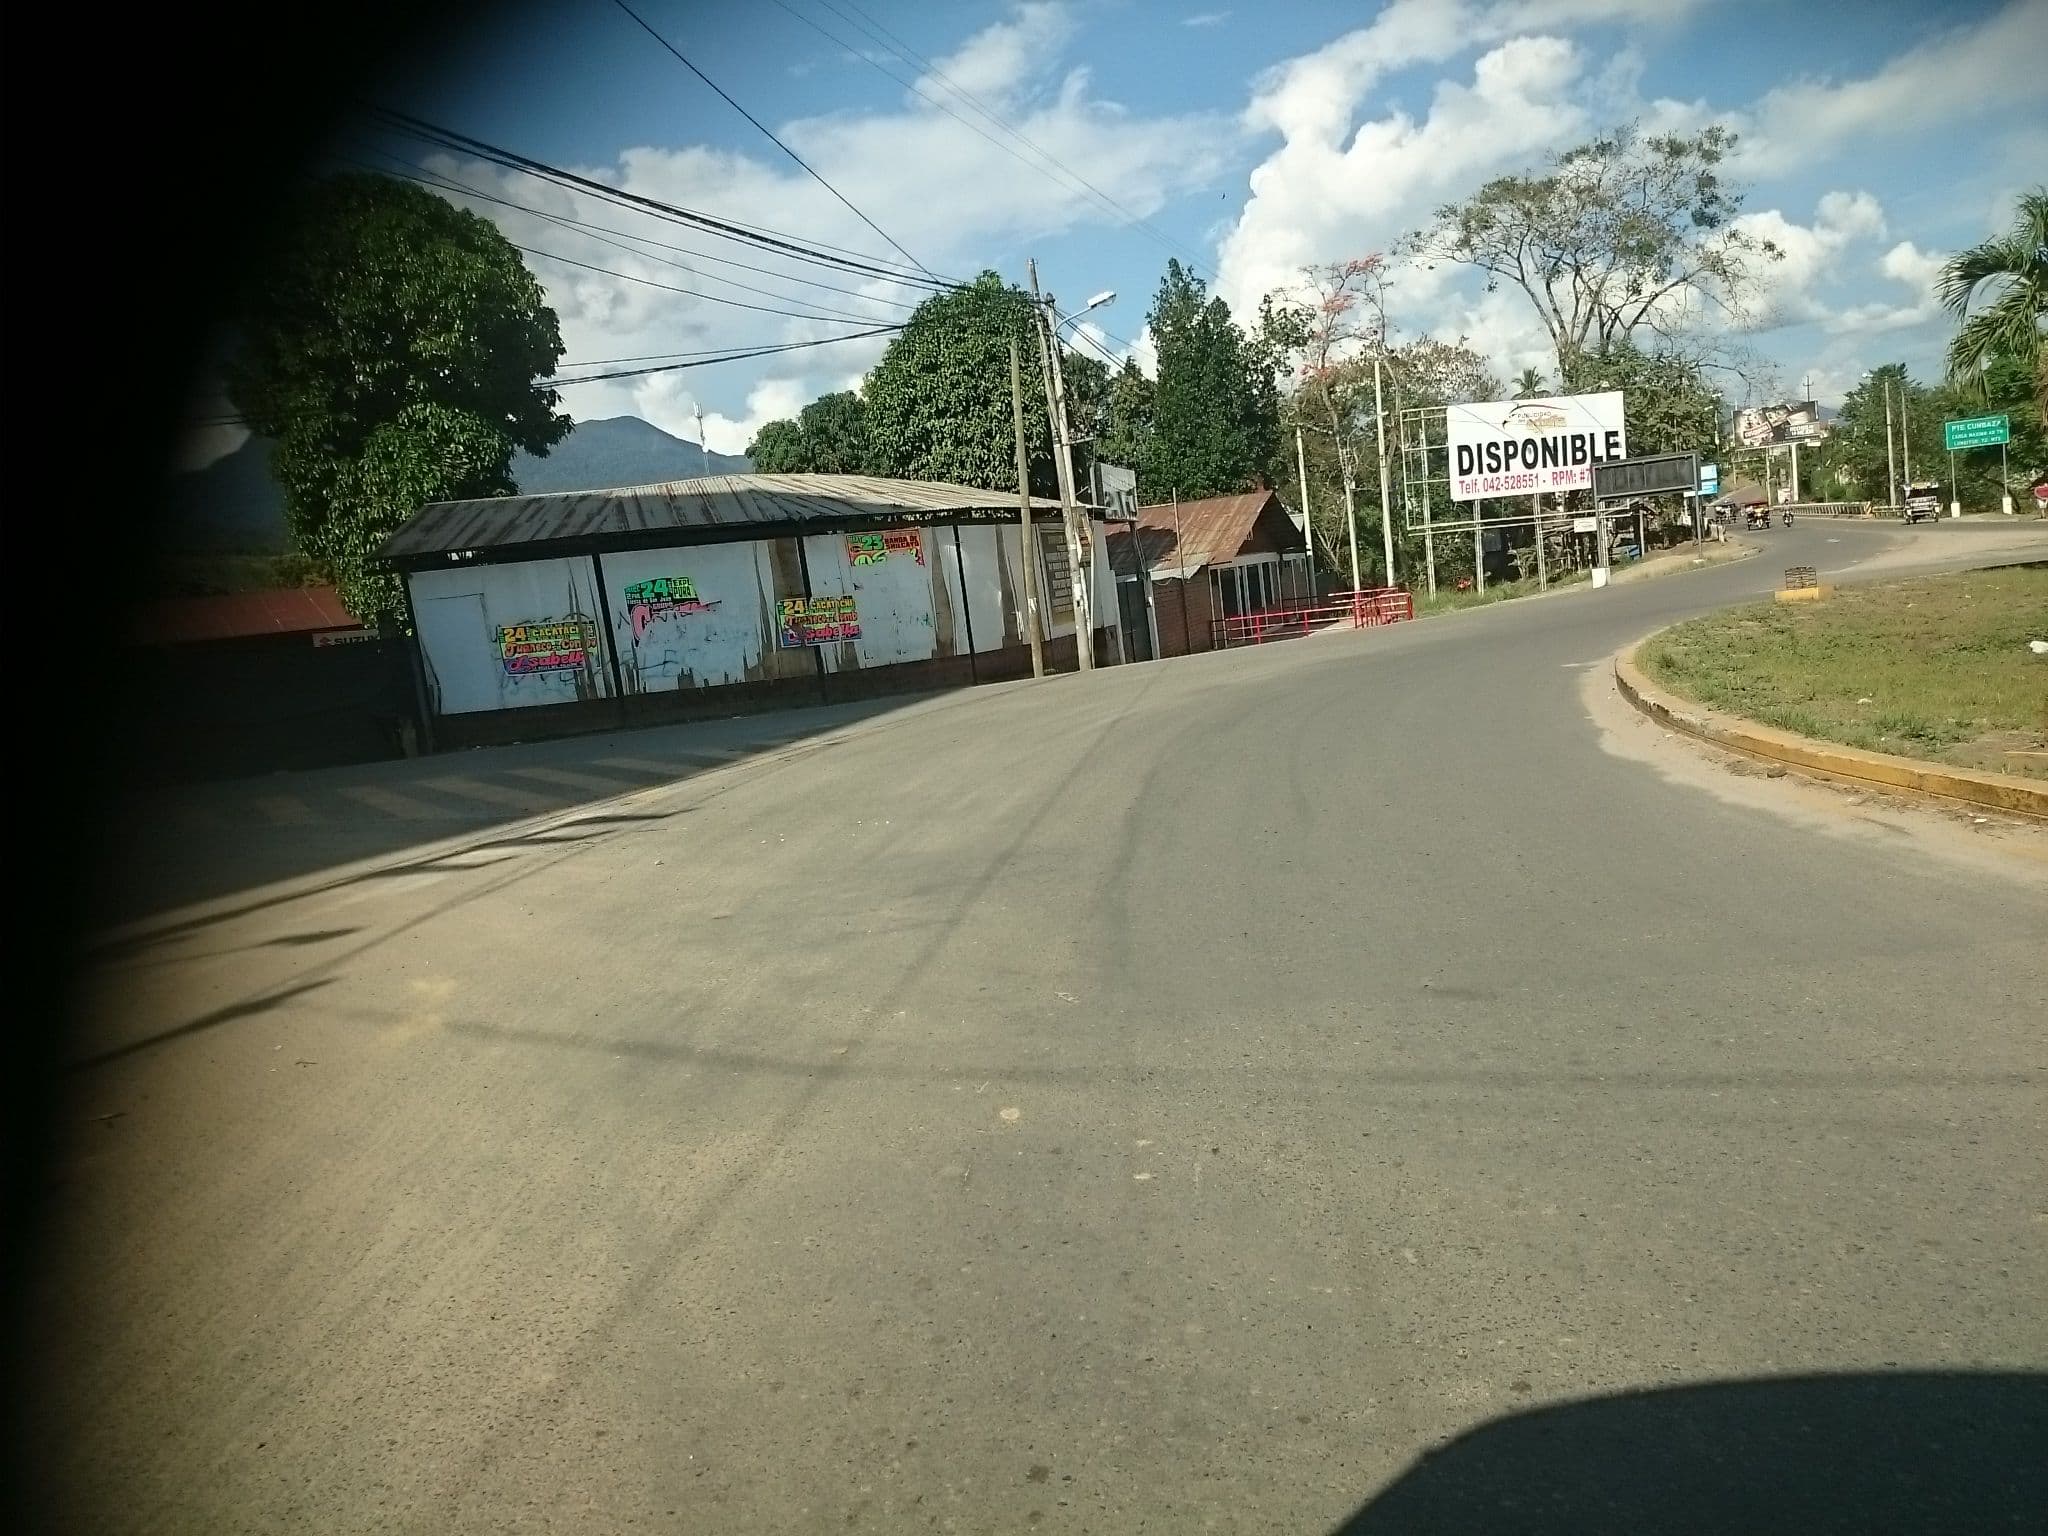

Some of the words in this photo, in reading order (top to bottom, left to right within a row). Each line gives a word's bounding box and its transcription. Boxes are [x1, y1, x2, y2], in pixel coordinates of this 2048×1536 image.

[1457, 430, 1621, 477] DISPONIBLE
[1459, 478, 1480, 495] Telf.
[1483, 472, 1539, 492] 042-528551
[1552, 469, 1577, 486] RPM:
[861, 534, 884, 551] 23
[641, 579, 669, 599] 24
[783, 600, 805, 615] 24
[503, 626, 527, 644] 24
